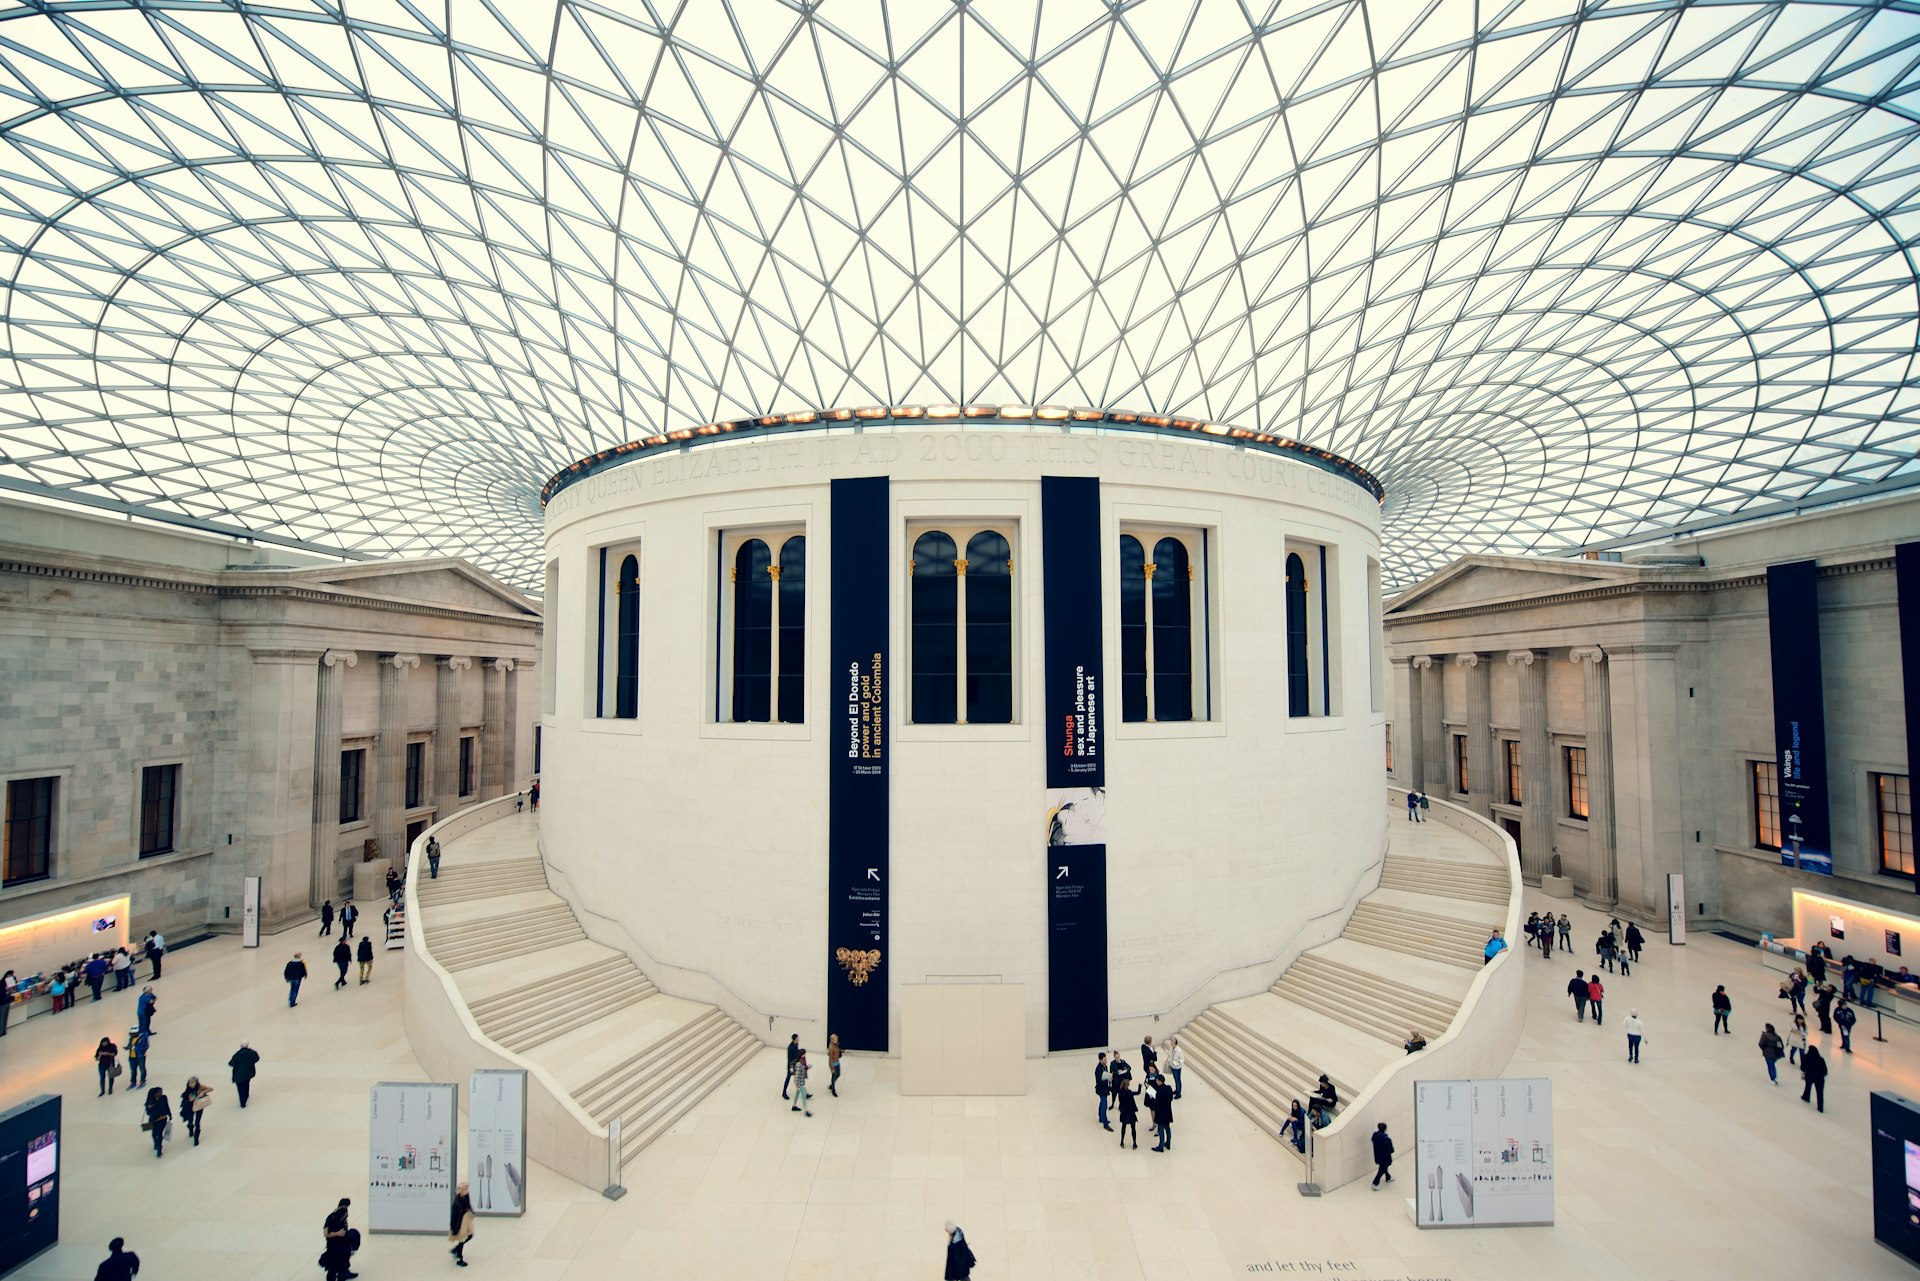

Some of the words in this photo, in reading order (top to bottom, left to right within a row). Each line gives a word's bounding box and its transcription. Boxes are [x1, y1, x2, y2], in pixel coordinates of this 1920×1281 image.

[587, 464, 644, 504] QUEEN
[651, 440, 805, 486] ELIZABETH
[816, 438, 839, 467] II
[851, 436, 903, 464] AD
[919, 434, 1008, 464] 2000
[1021, 434, 1100, 464] THIS
[1116, 440, 1215, 475] GREAT
[1225, 451, 1300, 489] COURT
[849, 662, 859, 701] Dorado
[861, 675, 871, 699] gold
[871, 652, 881, 704] Colombia
[1075, 665, 1085, 712] pleasure
[1086, 675, 1095, 691] art
[849, 704, 858, 714] El
[861, 702, 870, 722] and
[1086, 693, 1097, 743] Japanese
[872, 706, 881, 746] ancient
[1064, 715, 1074, 756] Shunga
[1075, 714, 1085, 735] and
[1791, 721, 1800, 749] legend
[849, 718, 860, 758] Beyond
[862, 724, 871, 758] power
[1077, 736, 1085, 756] sex
[1087, 745, 1096, 756] in
[872, 748, 881, 758] in
[1784, 749, 1792, 778] Vikings
[1792, 750, 1800, 765] and
[1792, 767, 1801, 779] life
[1246, 1261, 1273, 1272] and
[1276, 1259, 1296, 1272] let
[1299, 1260, 1322, 1273] thy
[1326, 1259, 1358, 1271] feet
